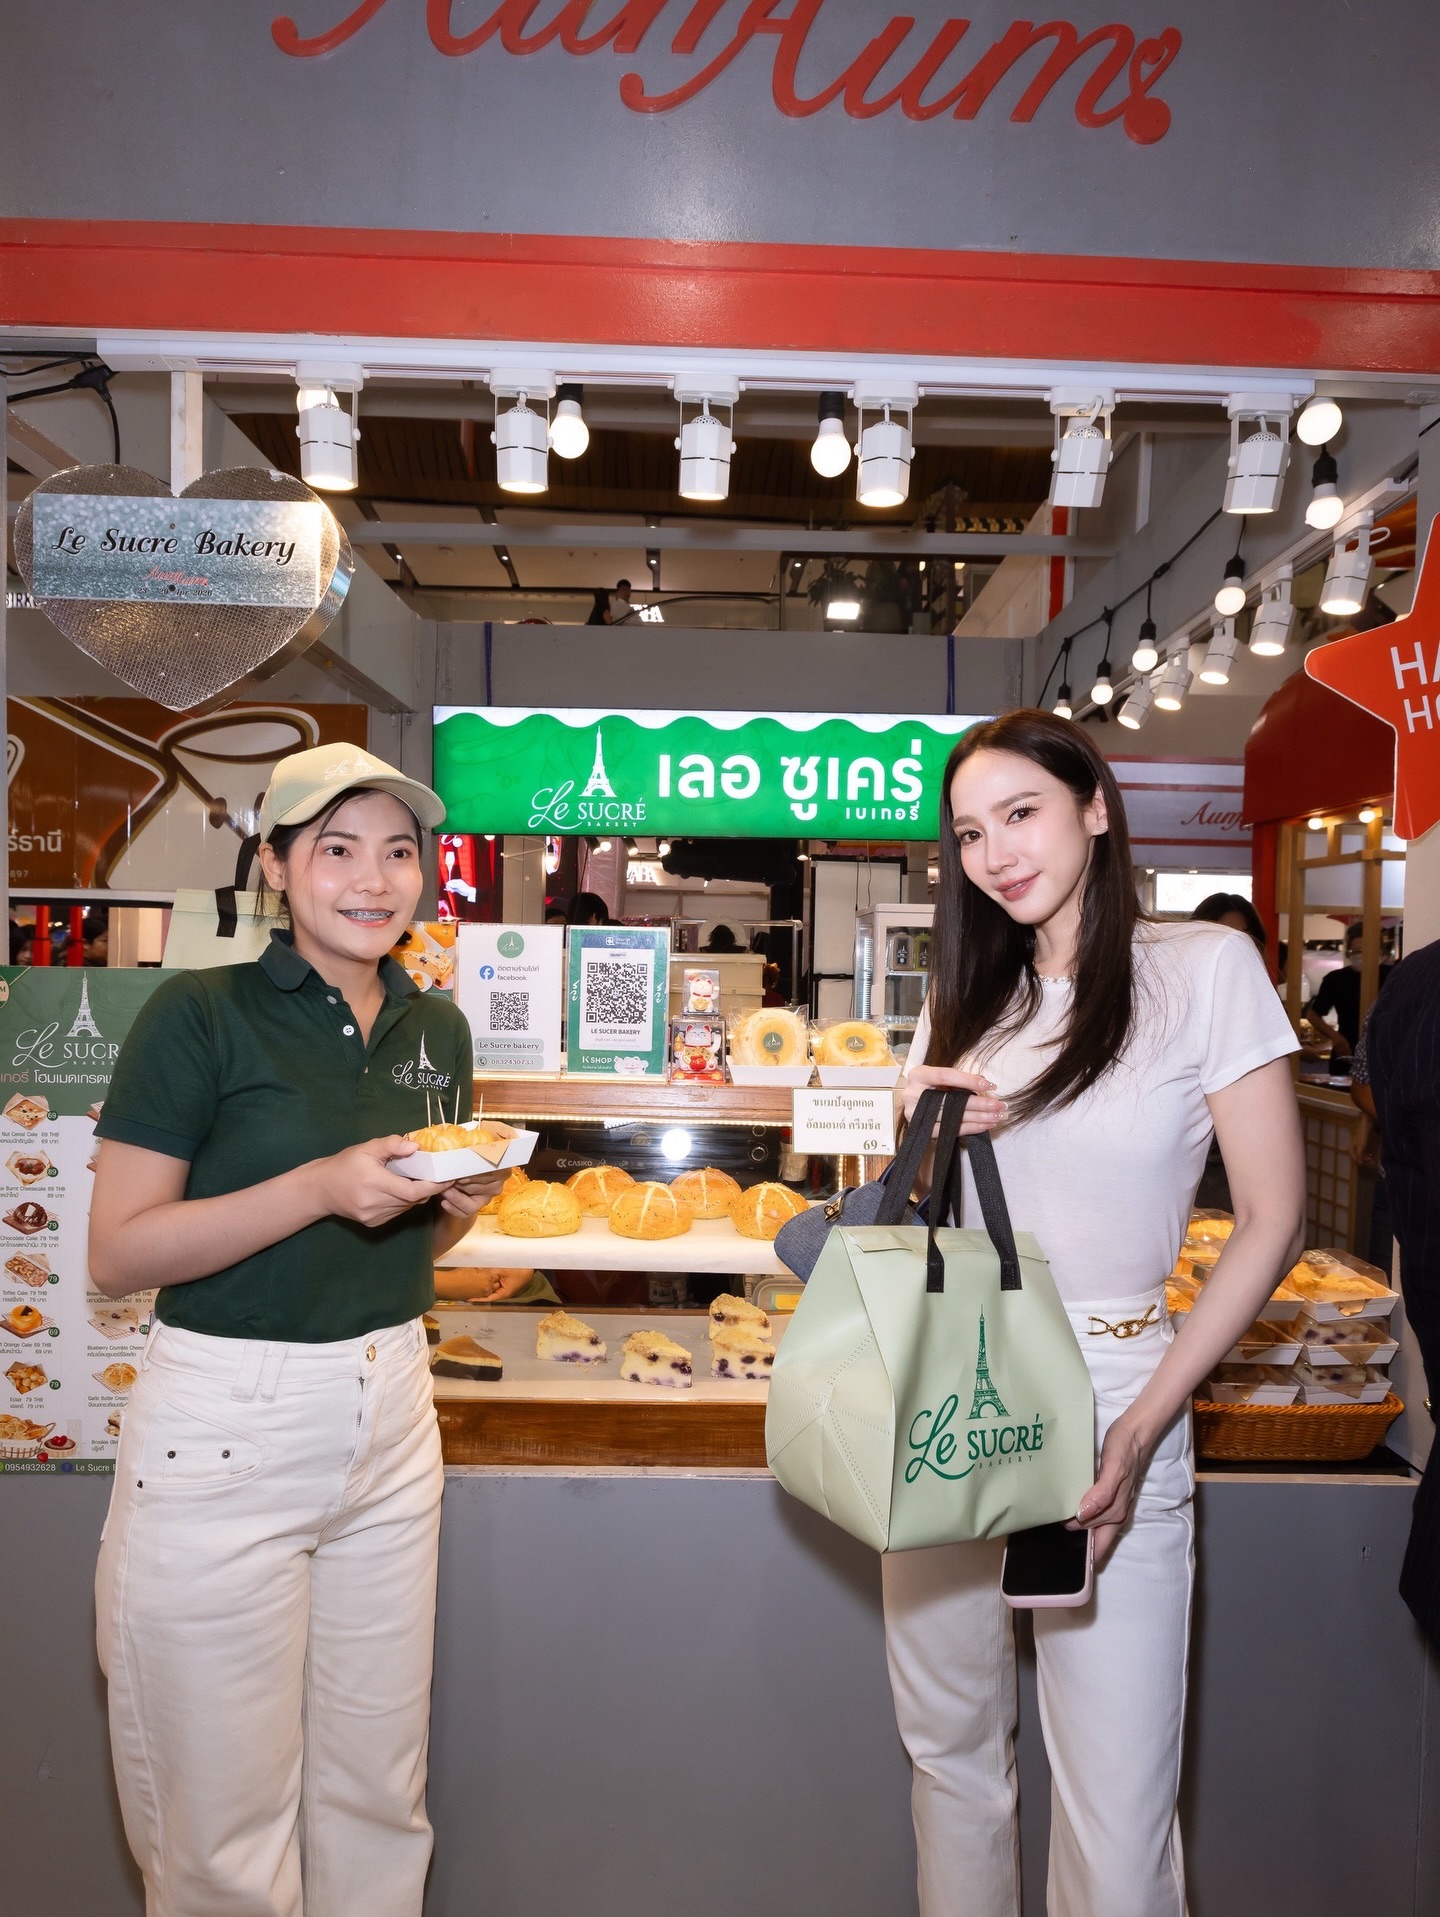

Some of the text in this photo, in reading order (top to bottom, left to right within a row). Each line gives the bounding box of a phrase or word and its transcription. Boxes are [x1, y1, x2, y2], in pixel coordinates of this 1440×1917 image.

[52, 526, 297, 566] Le Sucre Bakery
[658, 738, 923, 821] เลอ ซูเคร่
[528, 780, 647, 829] Le SUCRÉ
[12, 1021, 67, 1068] Le
[491, 1041, 511, 1049] Sucre
[513, 1042, 539, 1051] bakery
[391, 1060, 421, 1090] Le
[812, 1095, 874, 1110] ขนมปังลูกเกด
[863, 1139, 878, 1151] 69
[905, 1394, 1044, 1484] Le SUCRÉ
[5, 1463, 56, 1472] 0954932628
[76, 1463, 85, 1471] Le
[87, 1463, 110, 1472] Sucre
[979, 1455, 1033, 1470] BAKERY
